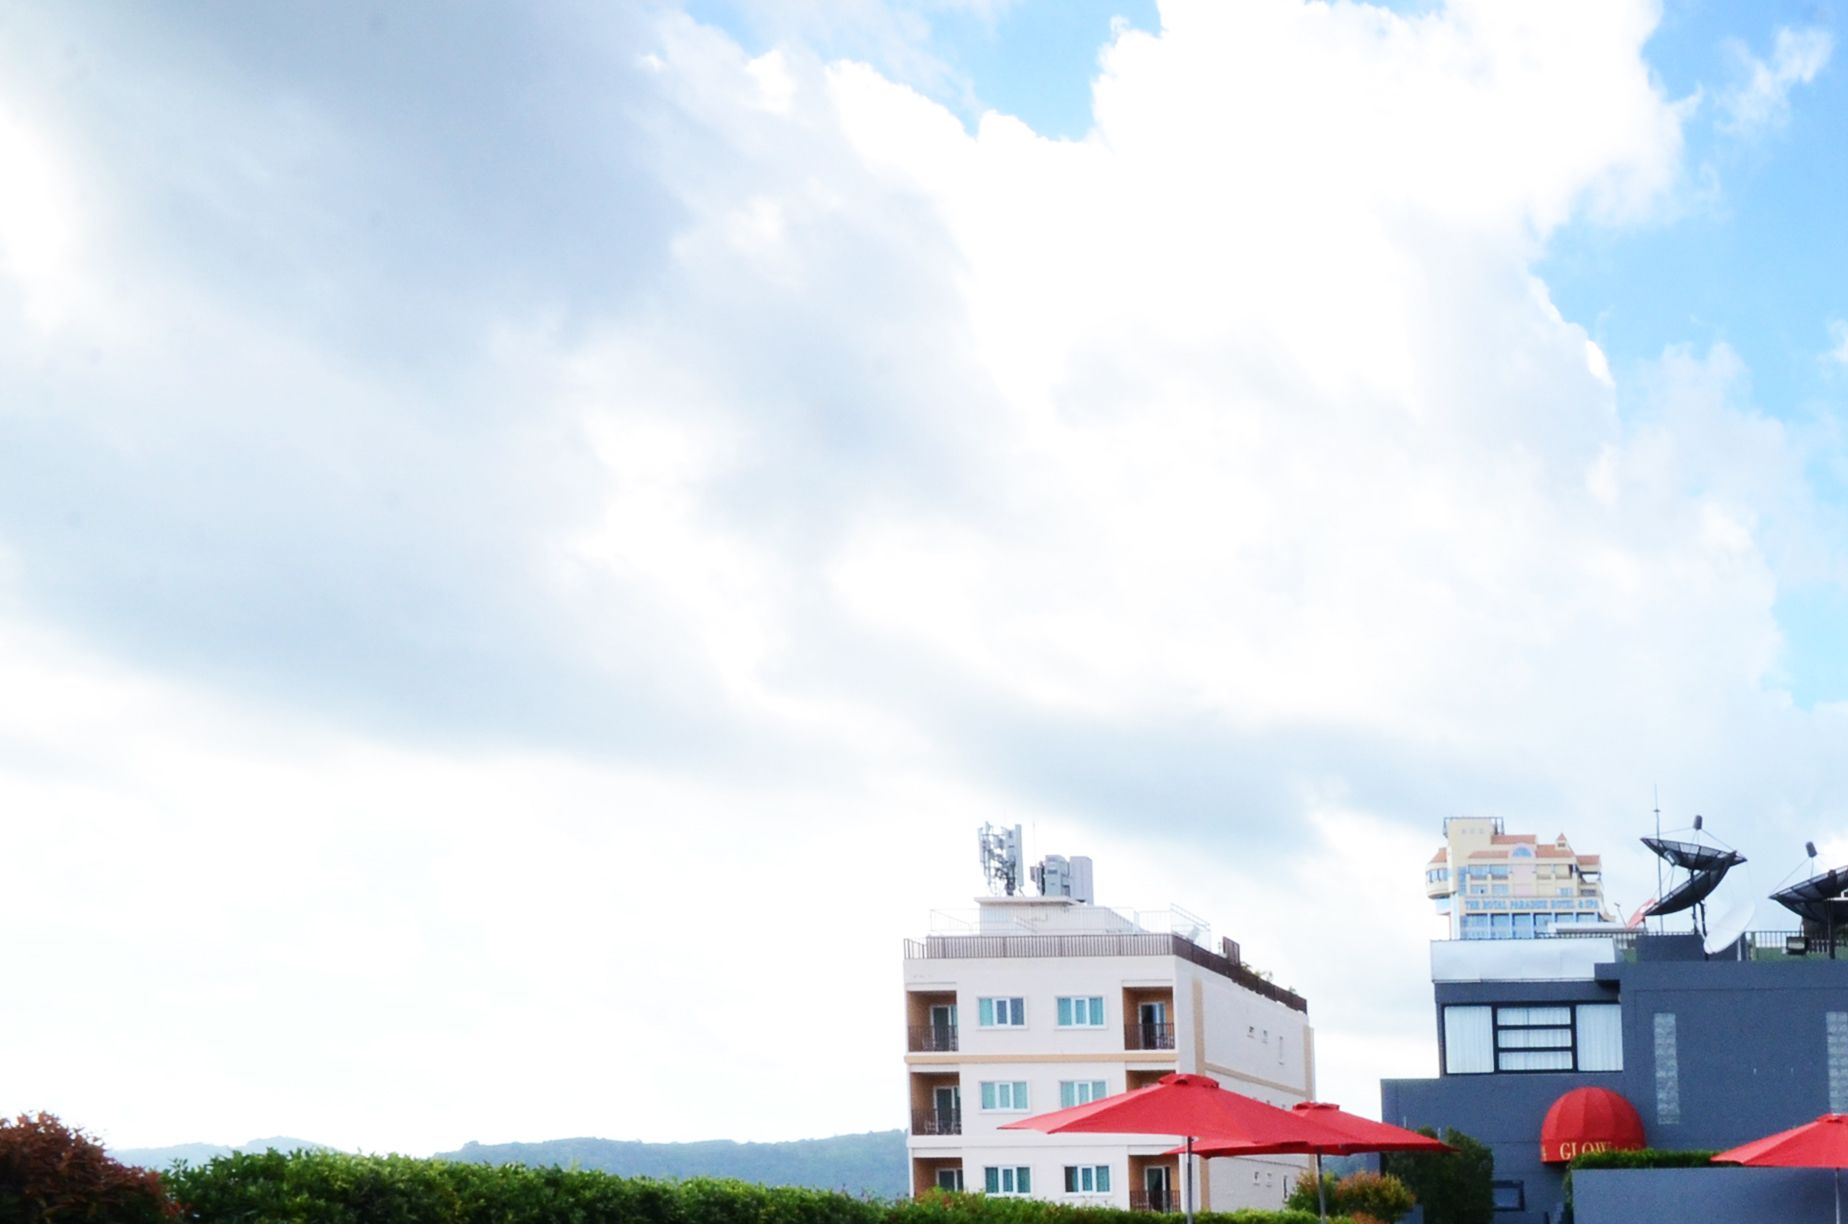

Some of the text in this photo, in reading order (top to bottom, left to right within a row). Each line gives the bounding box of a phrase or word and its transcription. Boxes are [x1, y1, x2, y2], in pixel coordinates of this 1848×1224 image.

[1465, 900, 1480, 910] THE
[1482, 900, 1506, 910] ROYAL
[1510, 900, 1548, 910] PARADISE
[1551, 900, 1575, 910] HOTEL
[1585, 899, 1599, 910] SPA
